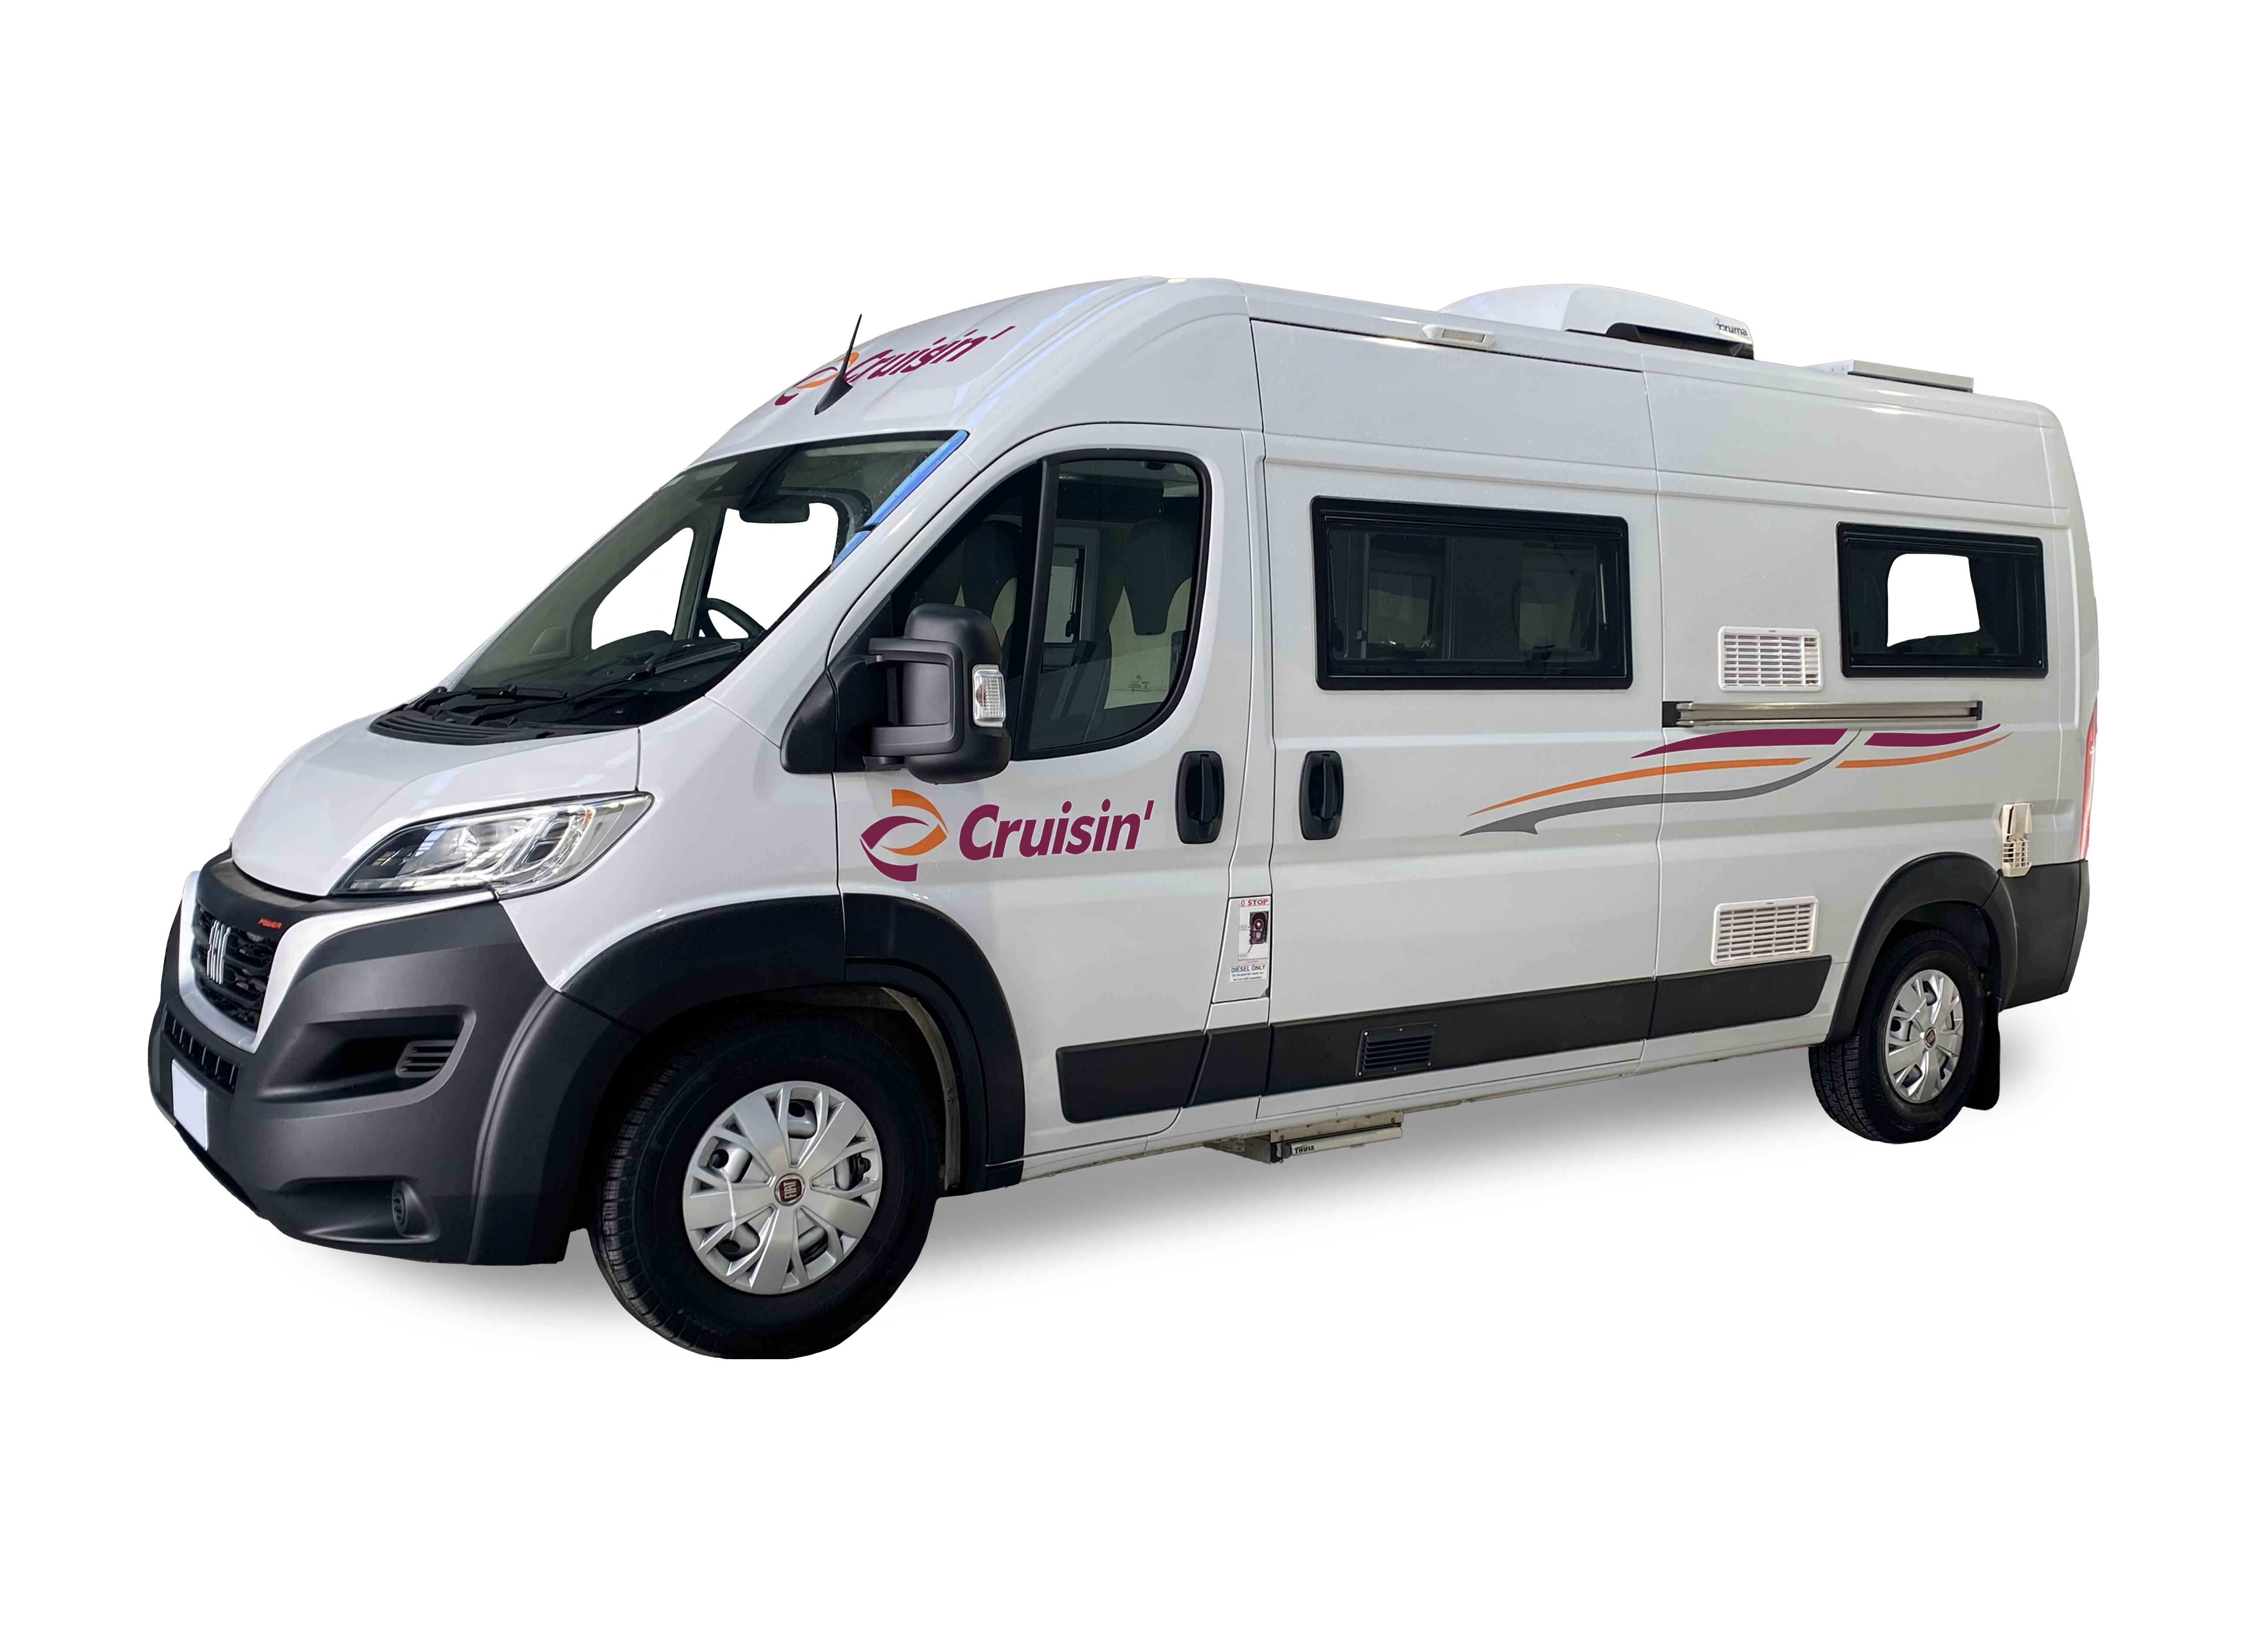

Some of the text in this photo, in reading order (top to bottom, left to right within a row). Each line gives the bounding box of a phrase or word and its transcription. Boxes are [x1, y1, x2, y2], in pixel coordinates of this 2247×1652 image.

[1715, 322, 1748, 336] truma
[843, 326, 1016, 383] Cruisin'
[959, 799, 1154, 861] Cruisin'
[784, 1181, 797, 1199] FIAT
